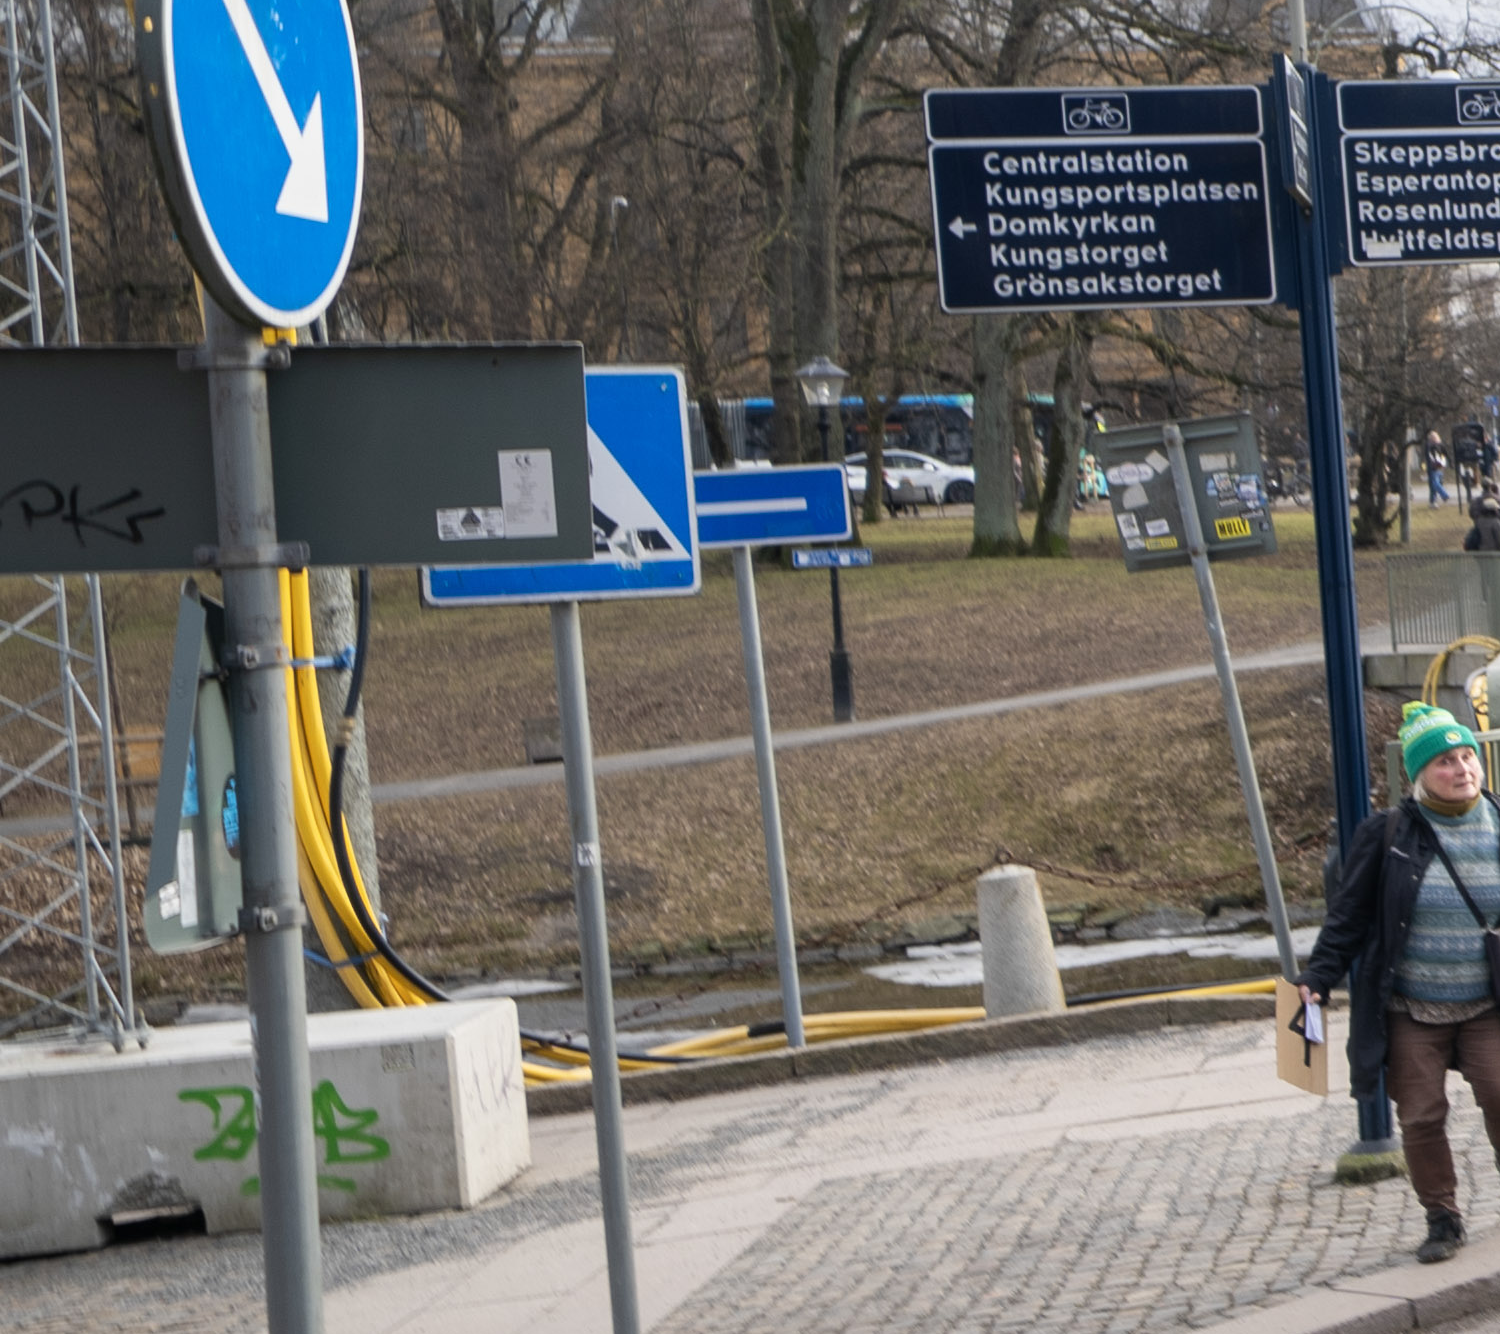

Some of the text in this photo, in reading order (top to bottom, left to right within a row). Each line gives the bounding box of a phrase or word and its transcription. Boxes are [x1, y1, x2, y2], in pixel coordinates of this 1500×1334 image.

[983, 149, 1188, 175] Centralstation
[985, 179, 1258, 209] Kungsportsplatsen
[987, 211, 1156, 239] Domkyrkan
[990, 240, 1168, 269] Kungstorget
[994, 269, 1222, 297] Grönsakstorget
